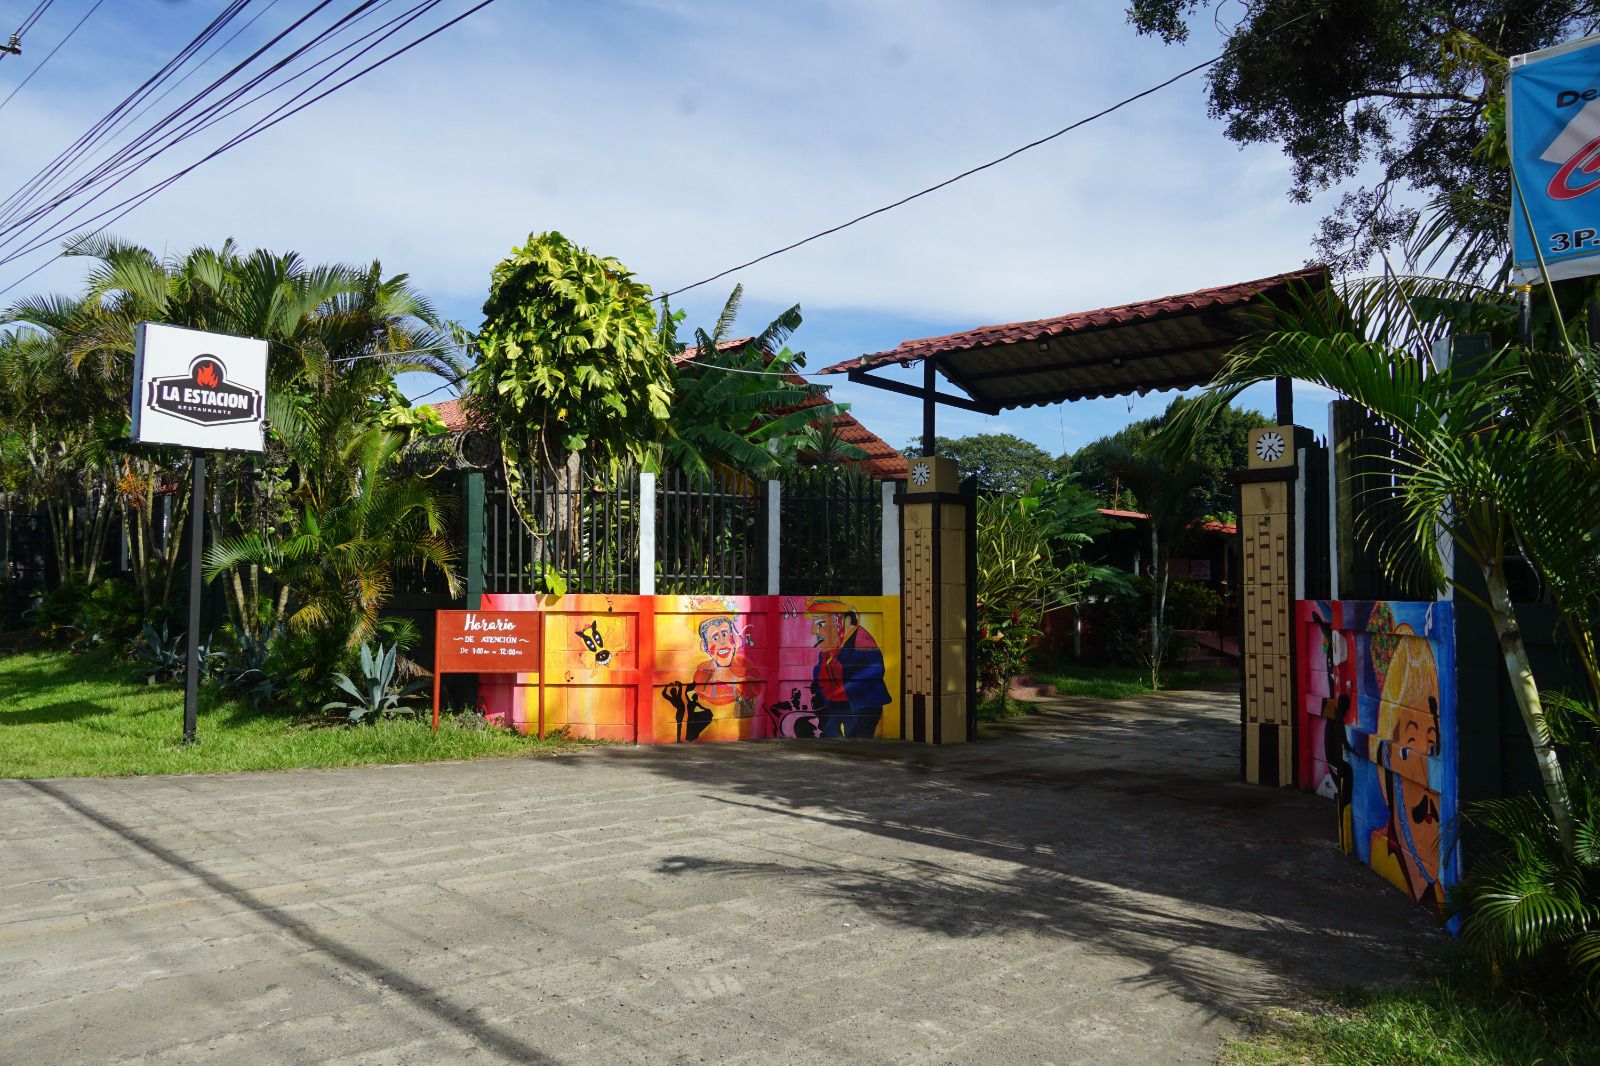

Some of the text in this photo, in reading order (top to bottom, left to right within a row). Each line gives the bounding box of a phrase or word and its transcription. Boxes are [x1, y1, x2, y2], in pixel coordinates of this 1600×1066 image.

[1556, 89, 1600, 108] De
[162, 385, 249, 410] LA ESTACION
[177, 404, 232, 416] RESTAURANTE
[464, 613, 516, 631] Horario
[464, 635, 517, 643] DE ATENCIÓN
